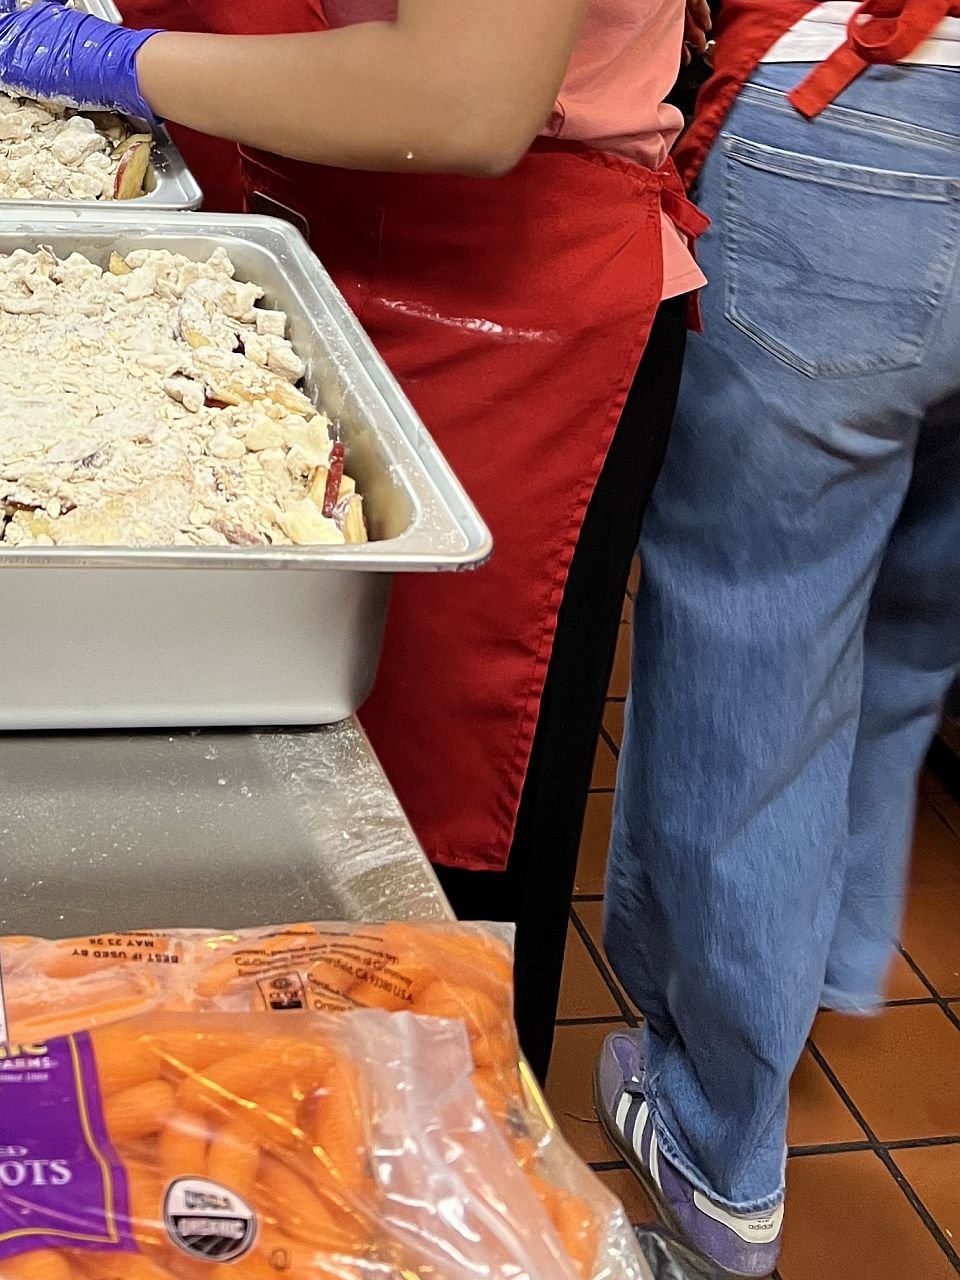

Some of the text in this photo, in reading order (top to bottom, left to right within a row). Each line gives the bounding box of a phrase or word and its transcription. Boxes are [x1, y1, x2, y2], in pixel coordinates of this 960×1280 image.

[127, 939, 154, 948] MAY
[72, 948, 179, 964] BEST IF USED BY
